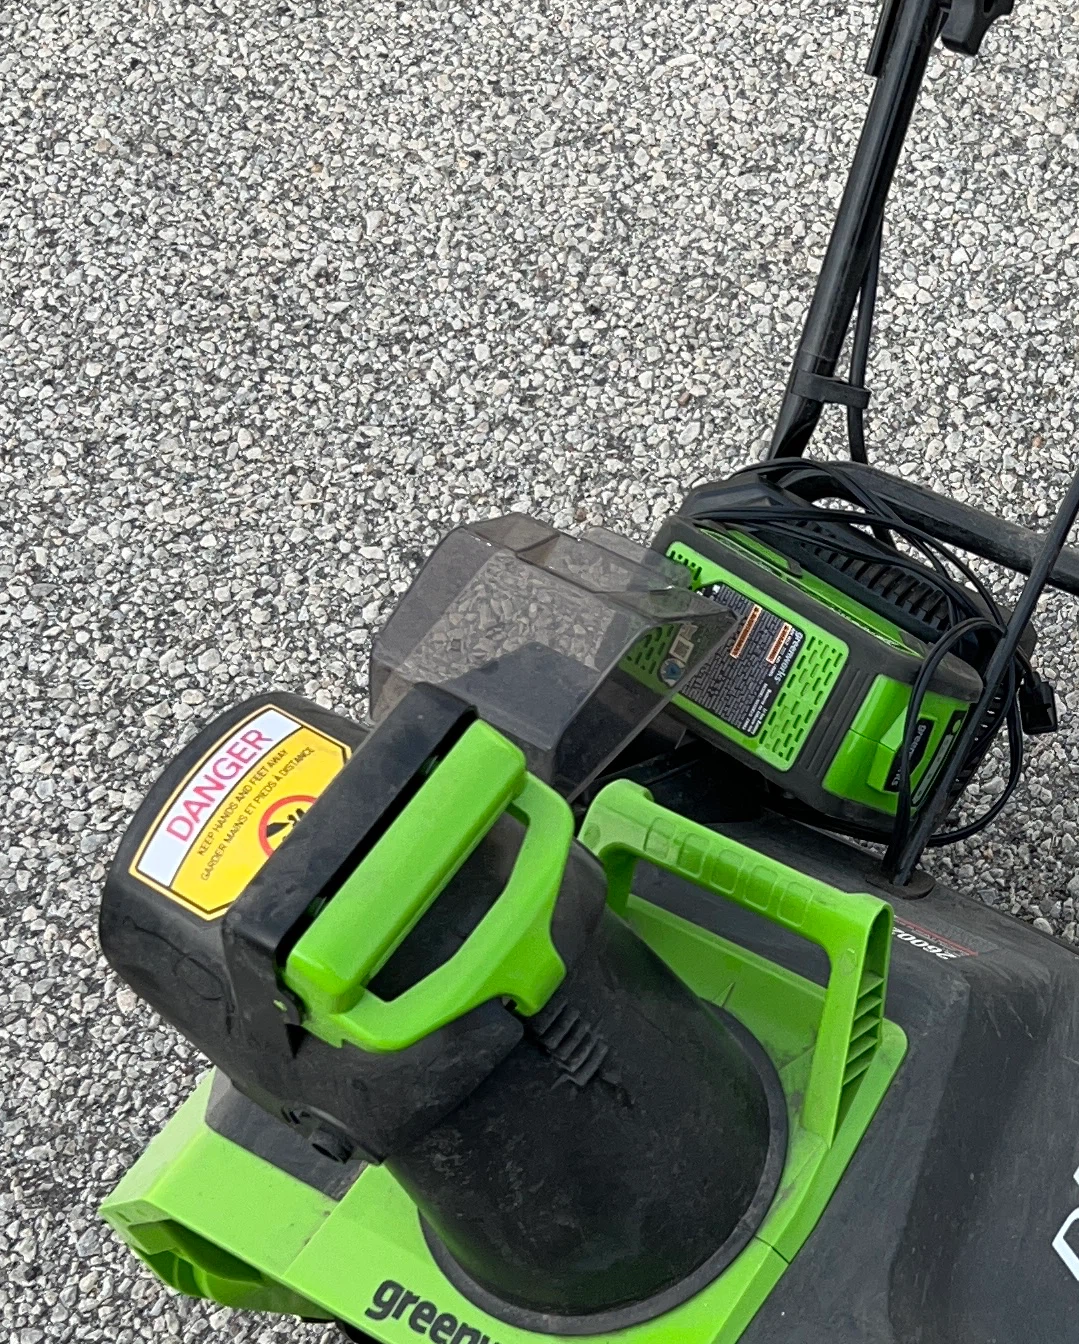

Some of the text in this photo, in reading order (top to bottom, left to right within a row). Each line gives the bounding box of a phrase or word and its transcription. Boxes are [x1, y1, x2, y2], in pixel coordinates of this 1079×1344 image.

[774, 630, 804, 684] greenworks
[165, 729, 274, 843] DANGER
[198, 749, 288, 856] KEEP HANDS AND FEET AWAY
[201, 842, 227, 881] GARDER
[223, 814, 248, 844] MAINS
[244, 803, 257, 815] ET
[253, 781, 277, 804] PIEDS
[278, 746, 315, 776] DISTANCE
